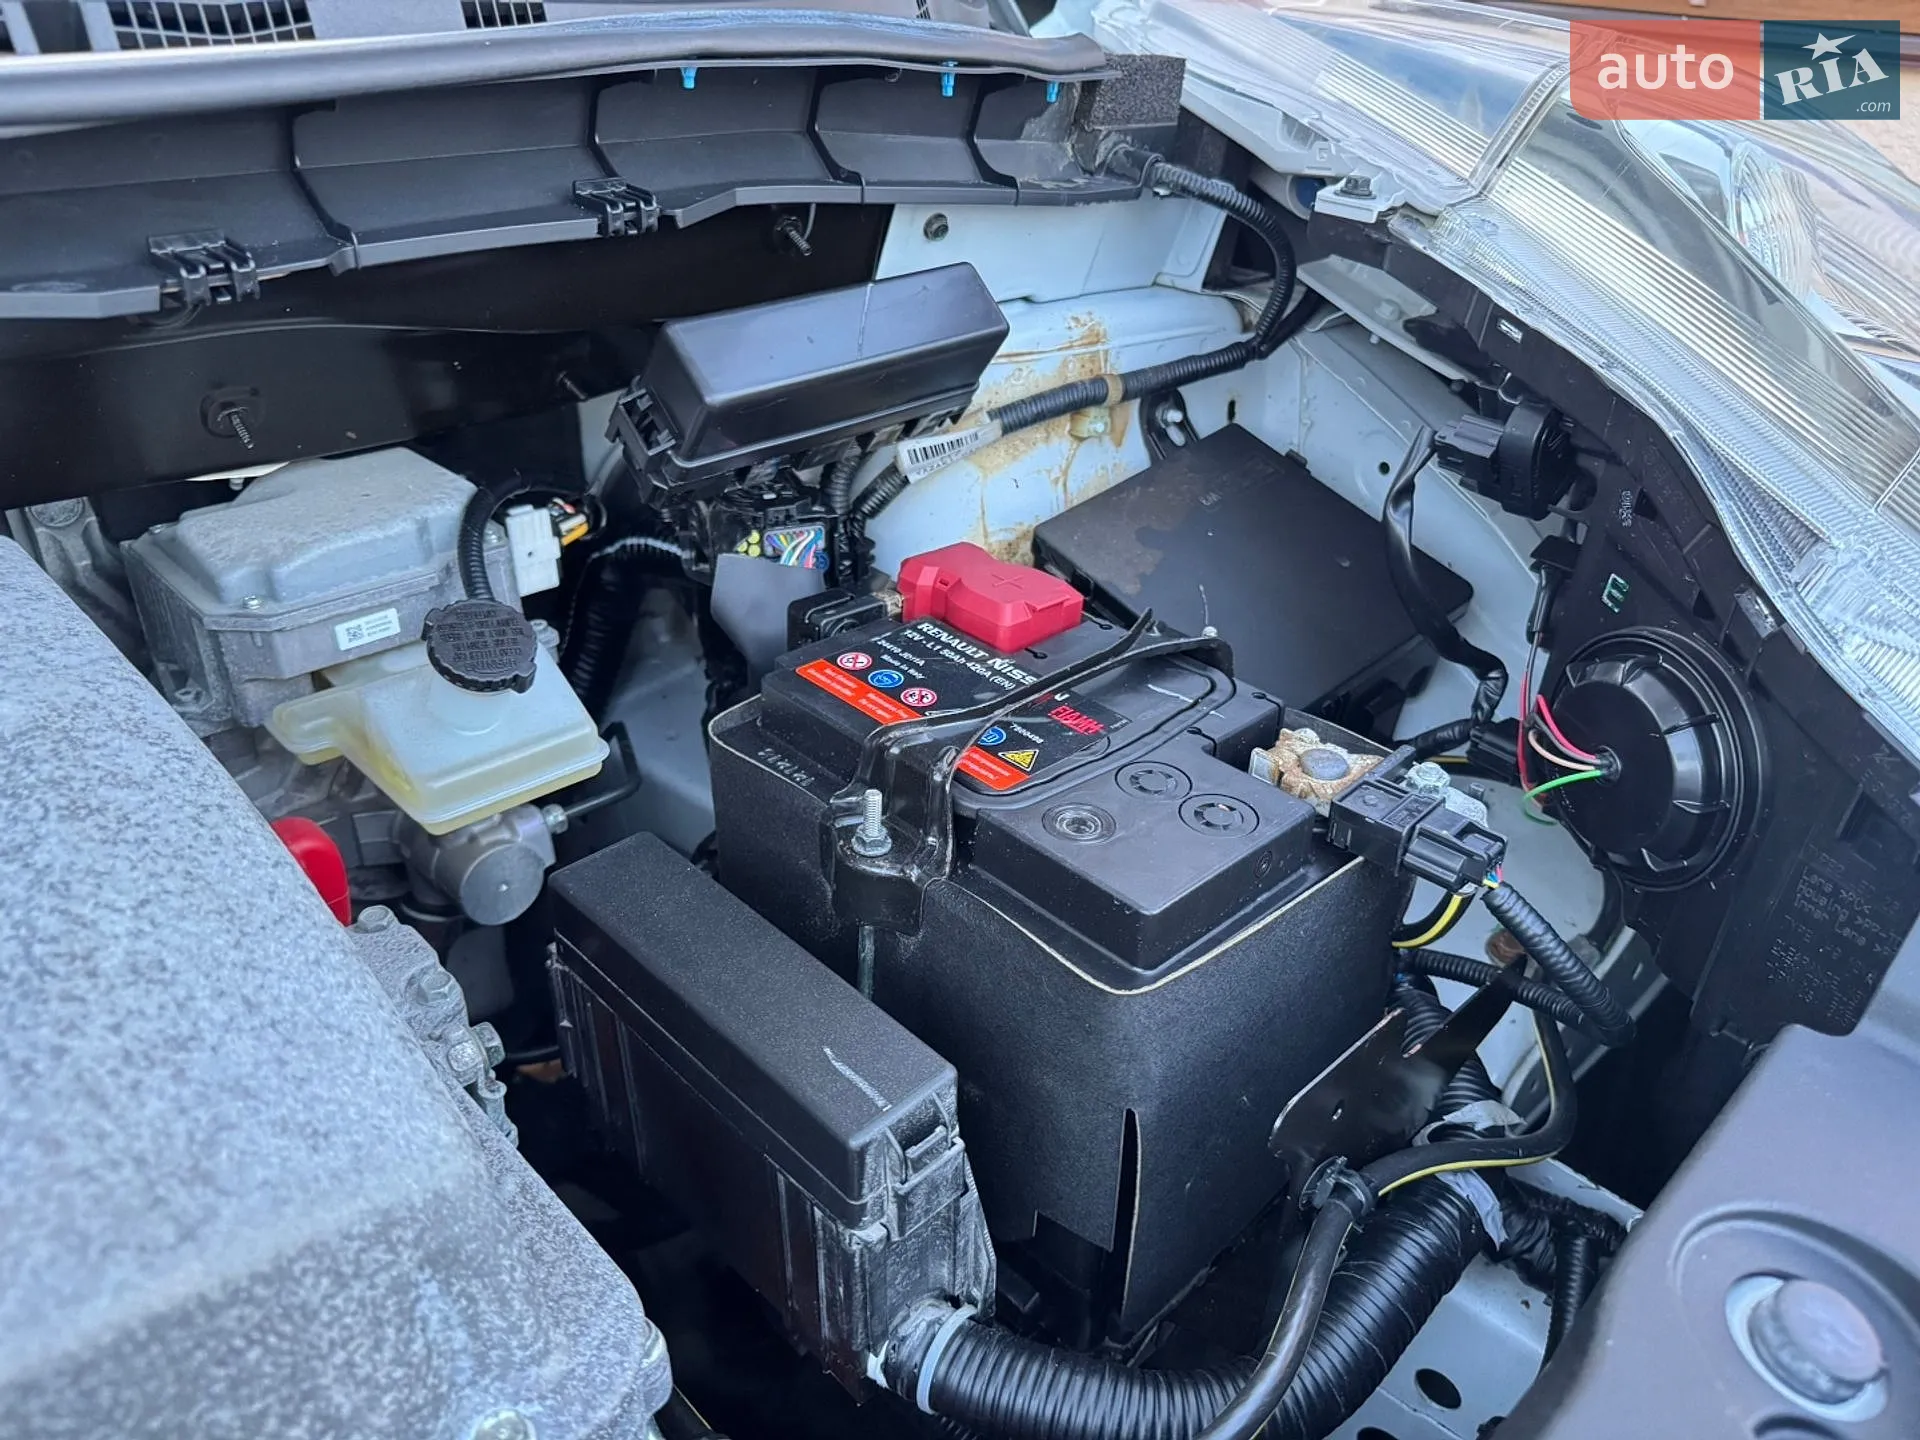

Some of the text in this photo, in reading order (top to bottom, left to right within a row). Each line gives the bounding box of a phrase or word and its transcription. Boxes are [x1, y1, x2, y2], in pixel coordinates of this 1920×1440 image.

[917, 622, 989, 659] RENAULT
[904, 629, 922, 642] 12V
[990, 674, 1016, 691] (EN)
[1048, 706, 1104, 735] FIAMM
